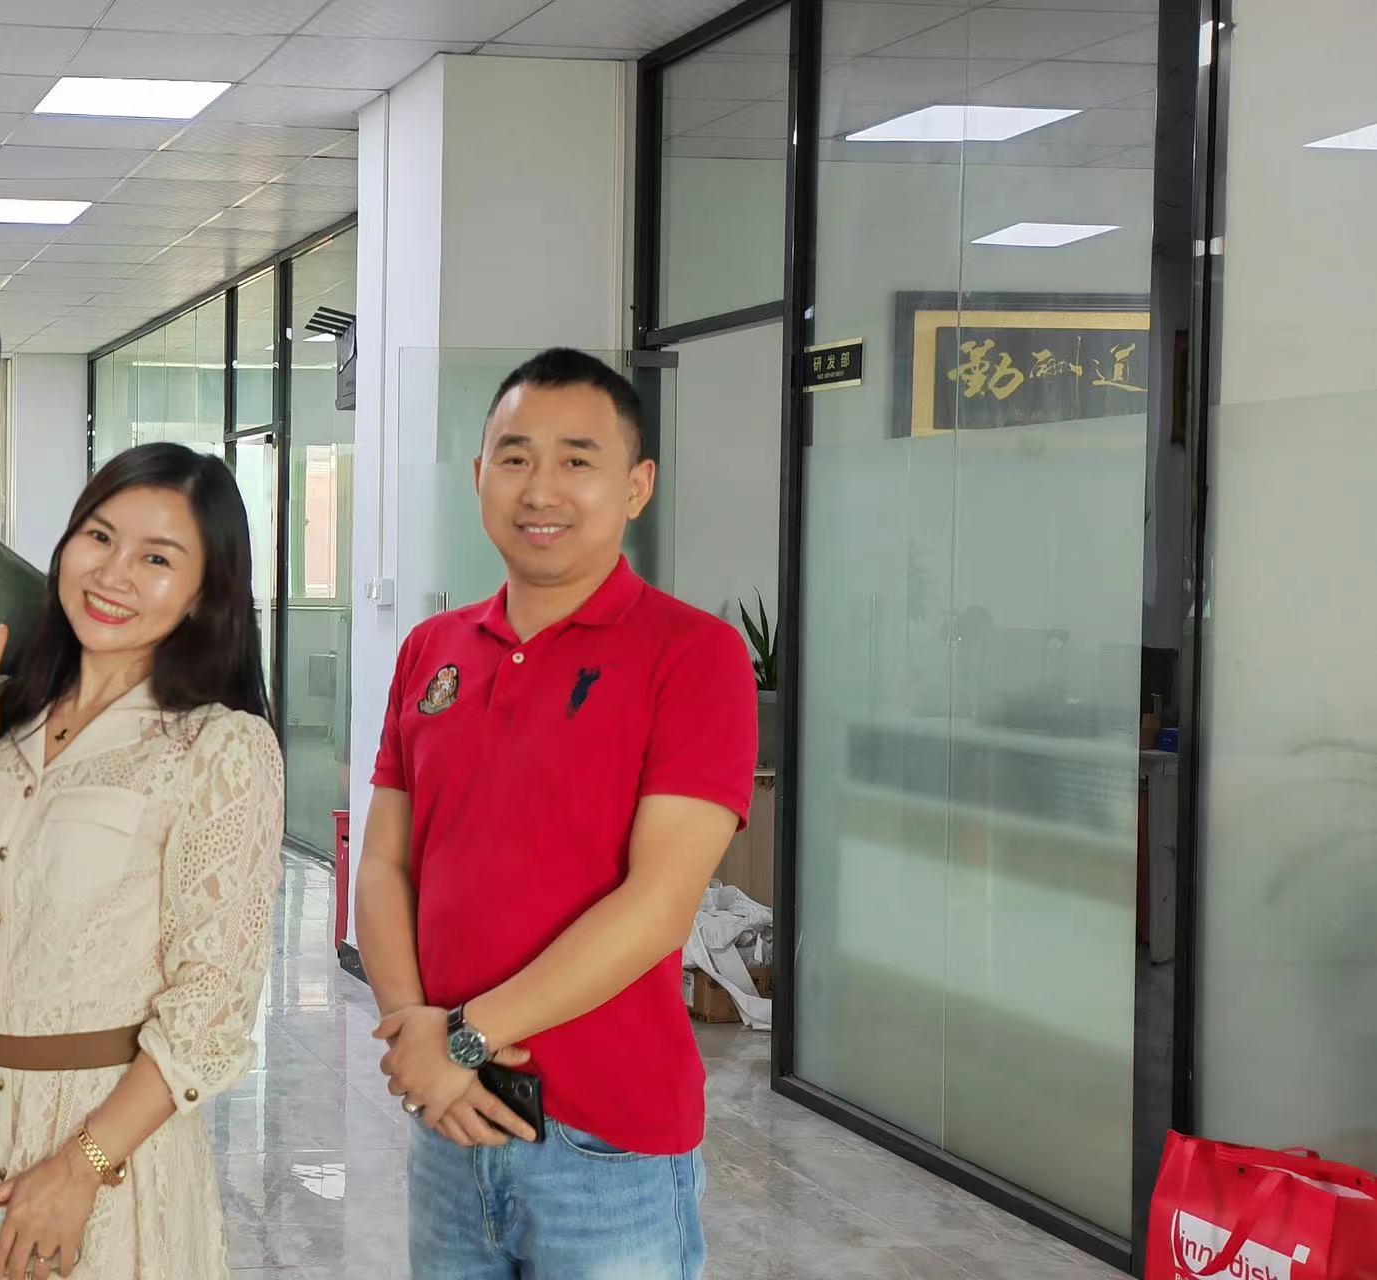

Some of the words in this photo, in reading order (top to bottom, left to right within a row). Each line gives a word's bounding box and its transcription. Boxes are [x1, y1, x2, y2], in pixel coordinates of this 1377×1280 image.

[813, 352, 851, 373] 研发部
[1179, 1231, 1279, 1280] inndisk
